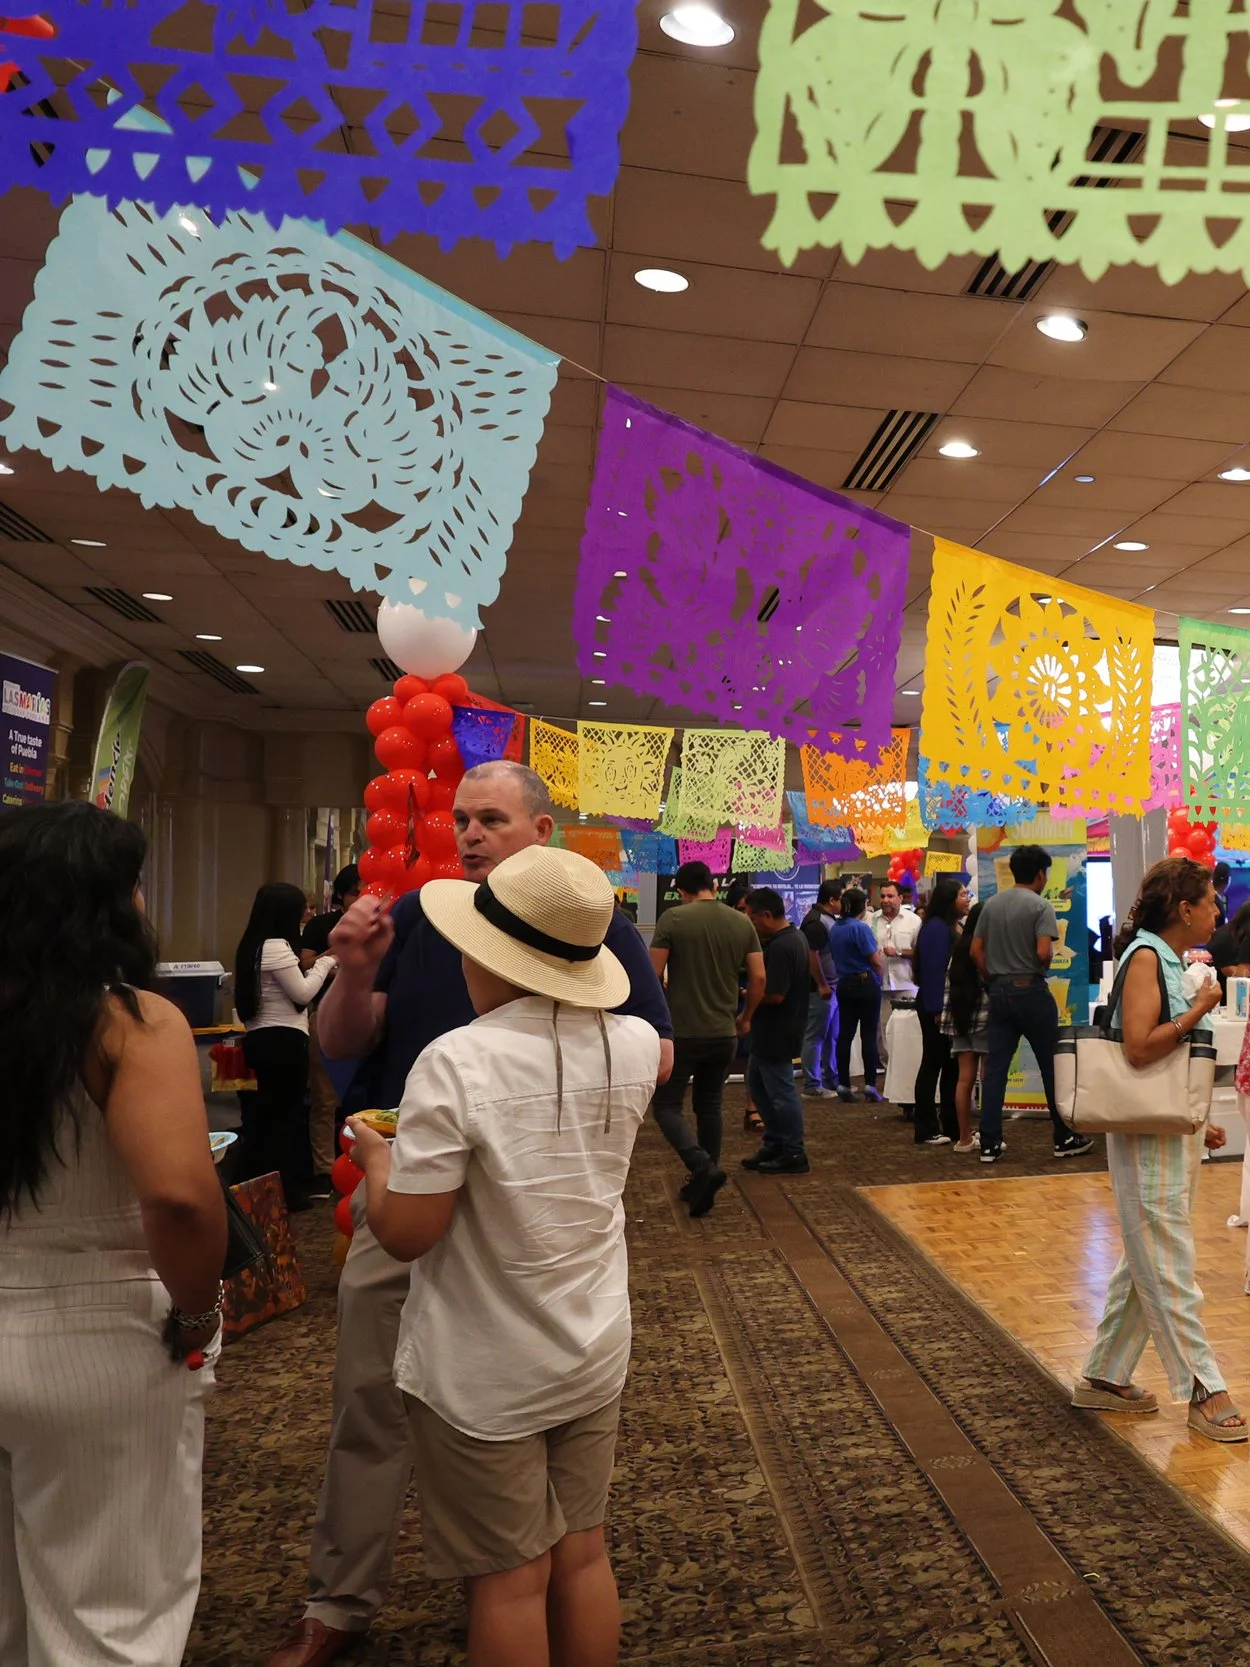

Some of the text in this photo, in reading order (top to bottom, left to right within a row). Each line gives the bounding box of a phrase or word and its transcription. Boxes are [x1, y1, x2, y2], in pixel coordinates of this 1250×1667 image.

[9, 729, 42, 747] A True taste
[11, 744, 37, 759] of Puebla
